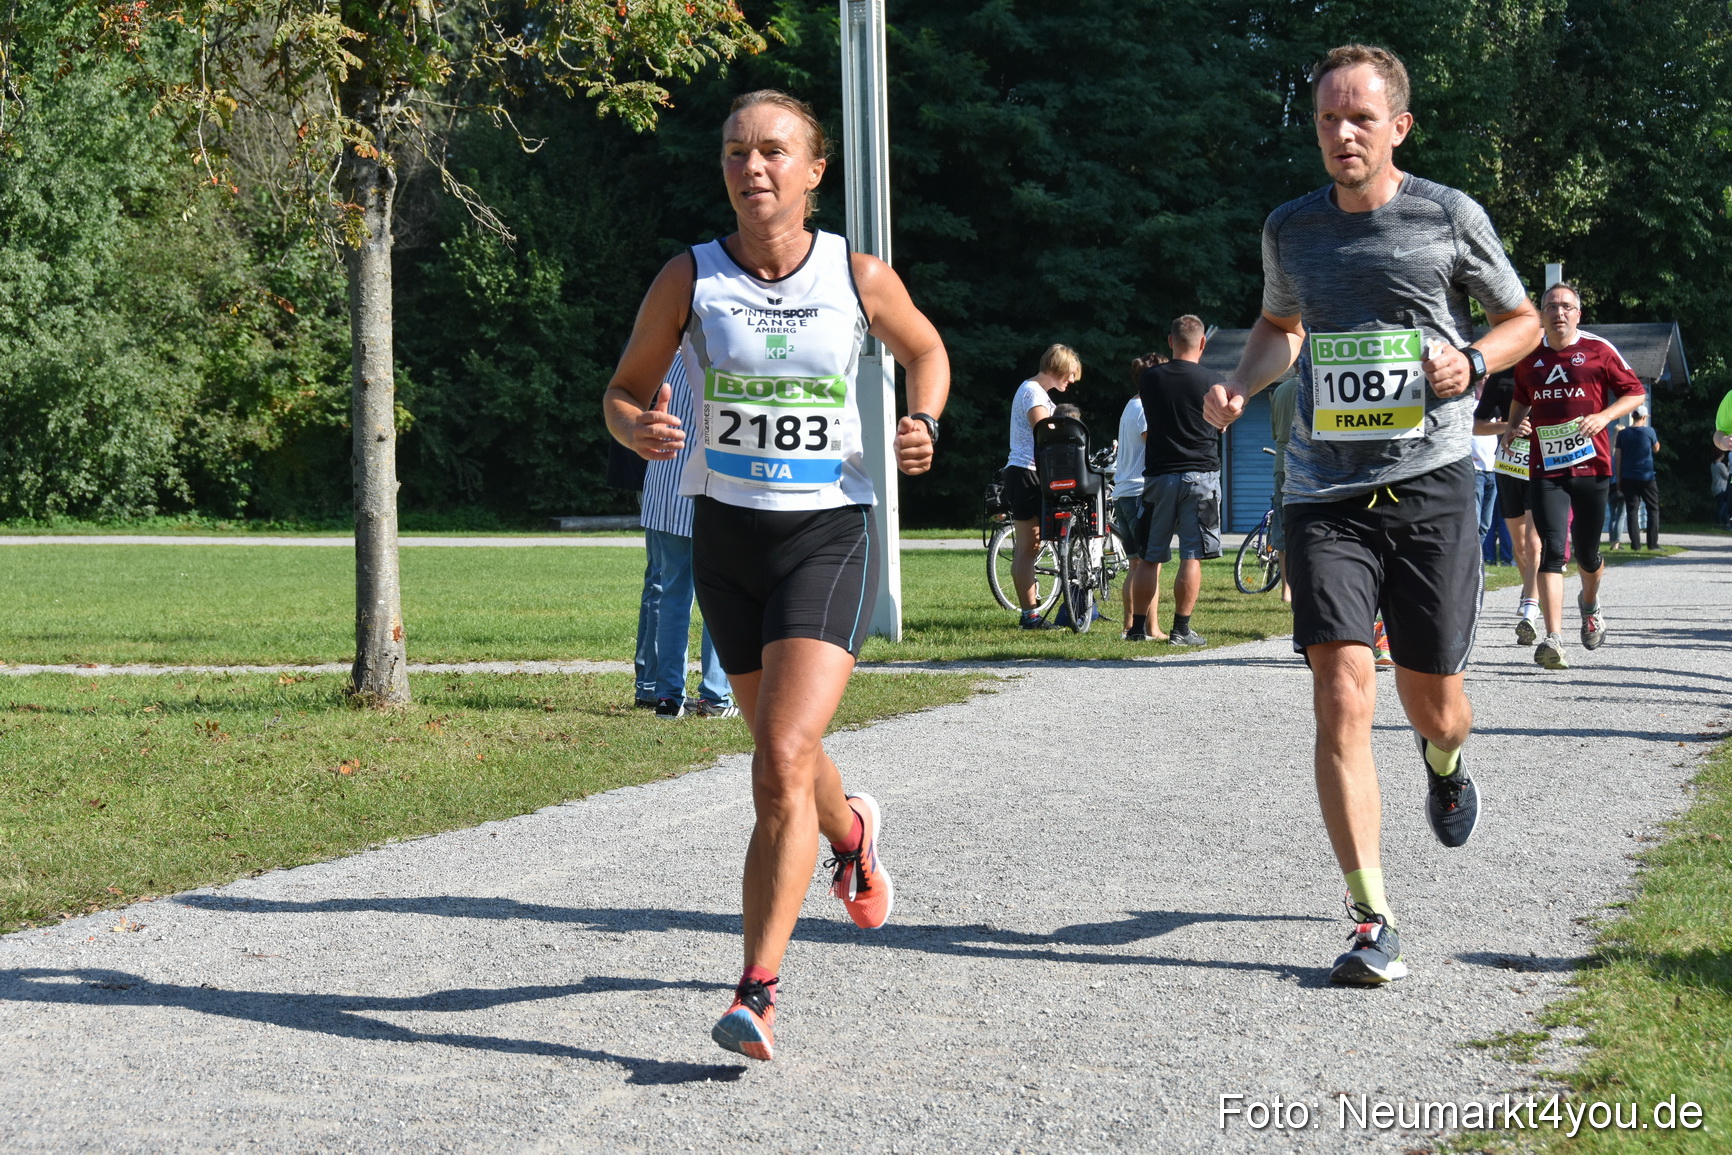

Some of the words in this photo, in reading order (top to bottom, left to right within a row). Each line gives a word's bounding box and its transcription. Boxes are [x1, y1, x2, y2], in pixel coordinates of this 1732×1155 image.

[744, 308, 819, 318] INTERSPORT
[747, 317, 808, 327] LANGE
[1316, 334, 1413, 362] BOCK
[714, 371, 837, 404] BOCK
[1324, 369, 1408, 403] 1087
[1533, 387, 1586, 400] AREVA
[834, 418, 841, 426] A
[1336, 413, 1394, 428] FRANZ
[718, 410, 828, 451] 2183
[1541, 422, 1579, 438] BOCK
[1545, 434, 1585, 454] 2786
[1553, 447, 1588, 464] MAREK
[751, 461, 793, 479] EVA
[1499, 463, 1526, 475] MICHAEL
